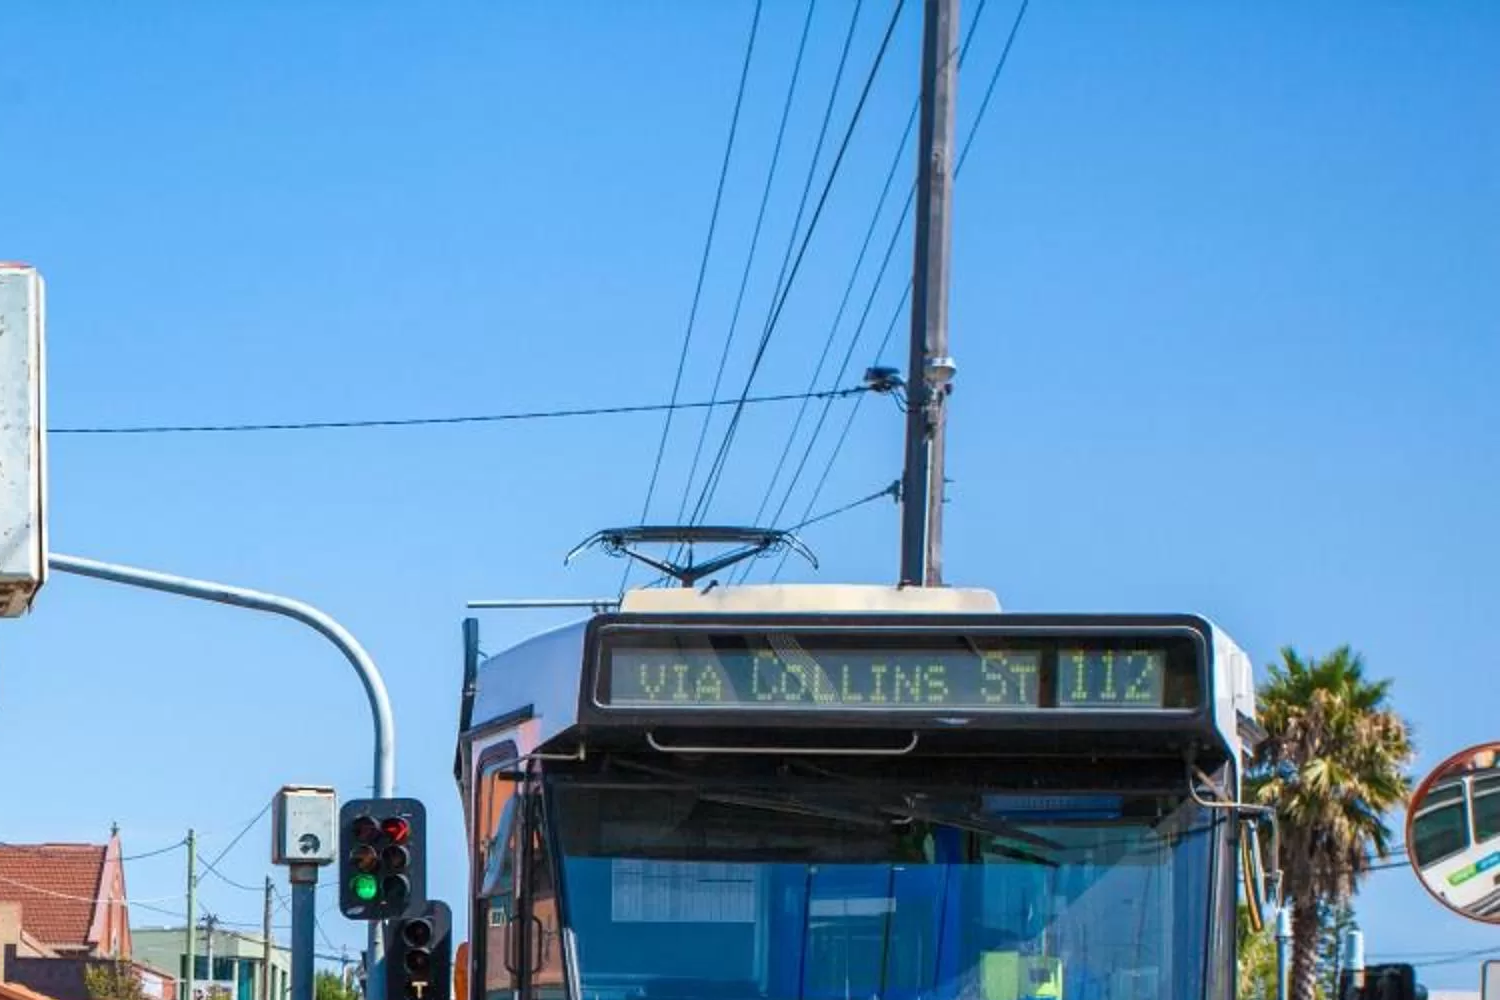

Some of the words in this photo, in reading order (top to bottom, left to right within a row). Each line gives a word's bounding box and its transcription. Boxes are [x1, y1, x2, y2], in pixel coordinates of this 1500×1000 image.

[639, 664, 721, 700] VIA
[753, 650, 948, 703] COLLINS
[980, 651, 1036, 703] ST
[1071, 650, 1152, 700] 112
